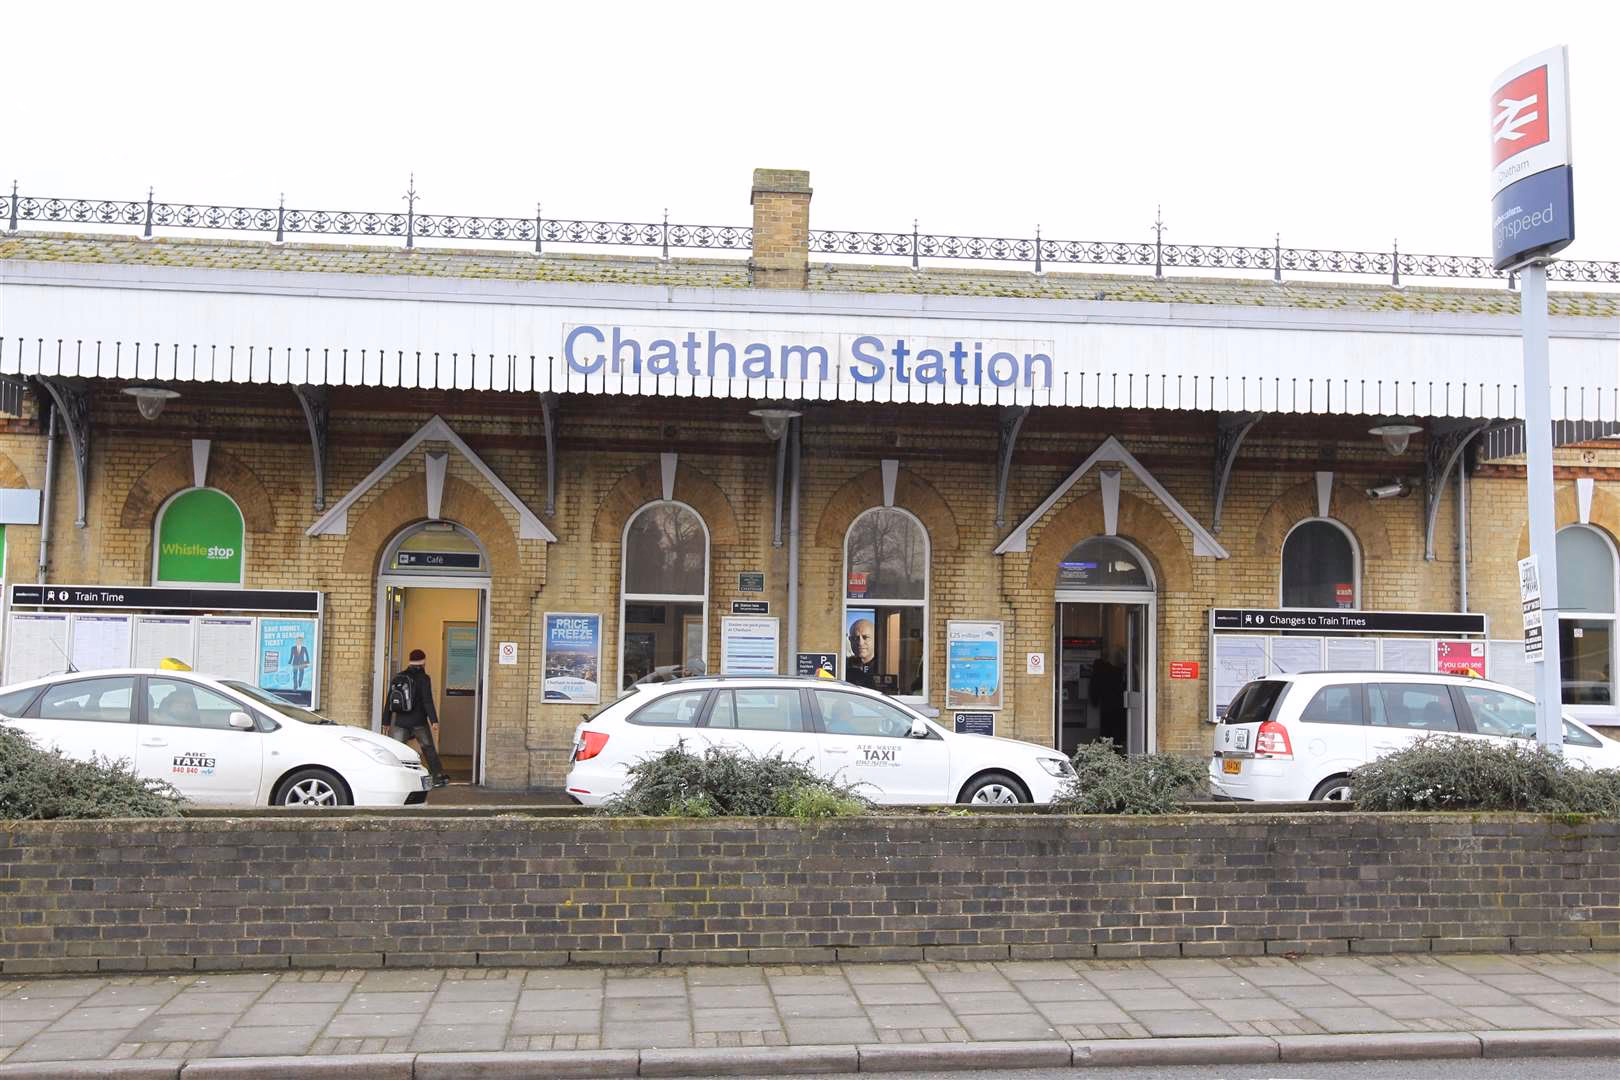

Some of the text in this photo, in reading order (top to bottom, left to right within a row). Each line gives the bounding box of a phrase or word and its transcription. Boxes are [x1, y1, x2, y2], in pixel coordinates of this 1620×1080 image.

[564, 325, 1054, 389] Chatham Station
[75, 591, 125, 602] Train Time
[556, 618, 589, 629] PRICE
[1269, 615, 1366, 627] Changes to Train Times
[551, 629, 593, 640] FREEZE
[863, 749, 895, 761] TAXI
[174, 756, 215, 767] TAXIS
